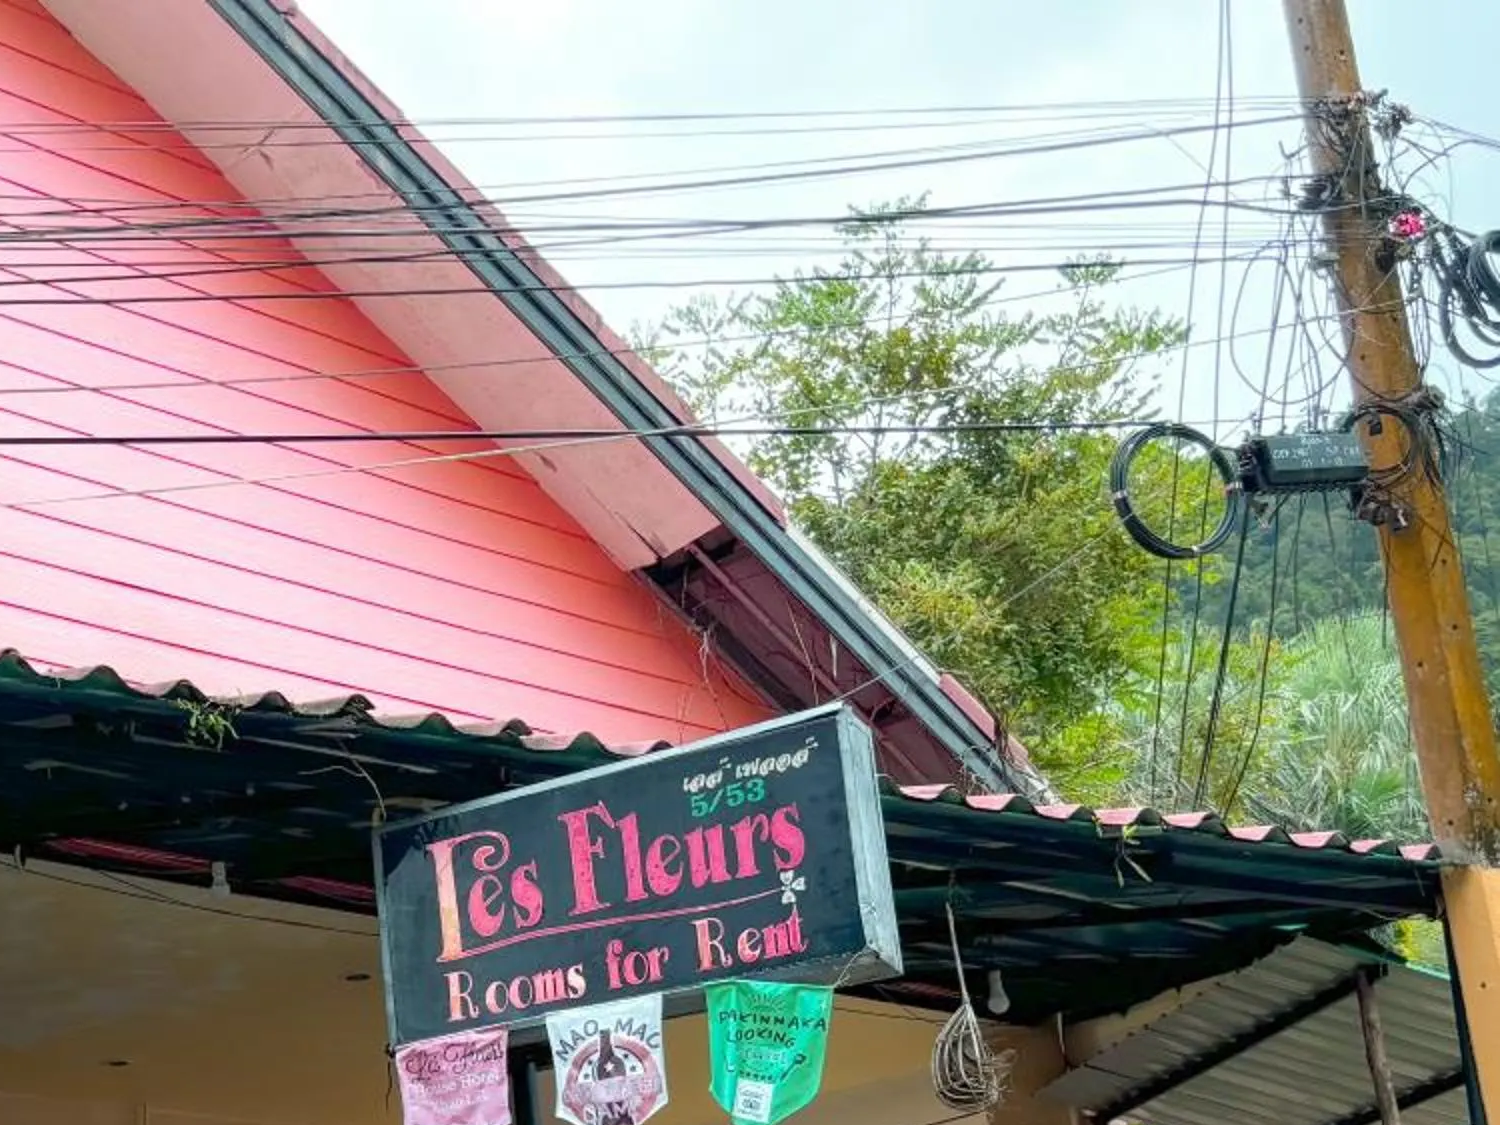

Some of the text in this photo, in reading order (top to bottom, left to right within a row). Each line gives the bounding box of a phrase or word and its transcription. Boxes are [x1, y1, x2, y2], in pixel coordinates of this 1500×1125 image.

[691, 777, 766, 817] 5/53
[427, 800, 807, 963] Les Fleurs
[443, 905, 810, 1023] Rooms for Rent
[555, 1018, 599, 1064] MAO
[719, 1010, 828, 1033] PAKINNAKA
